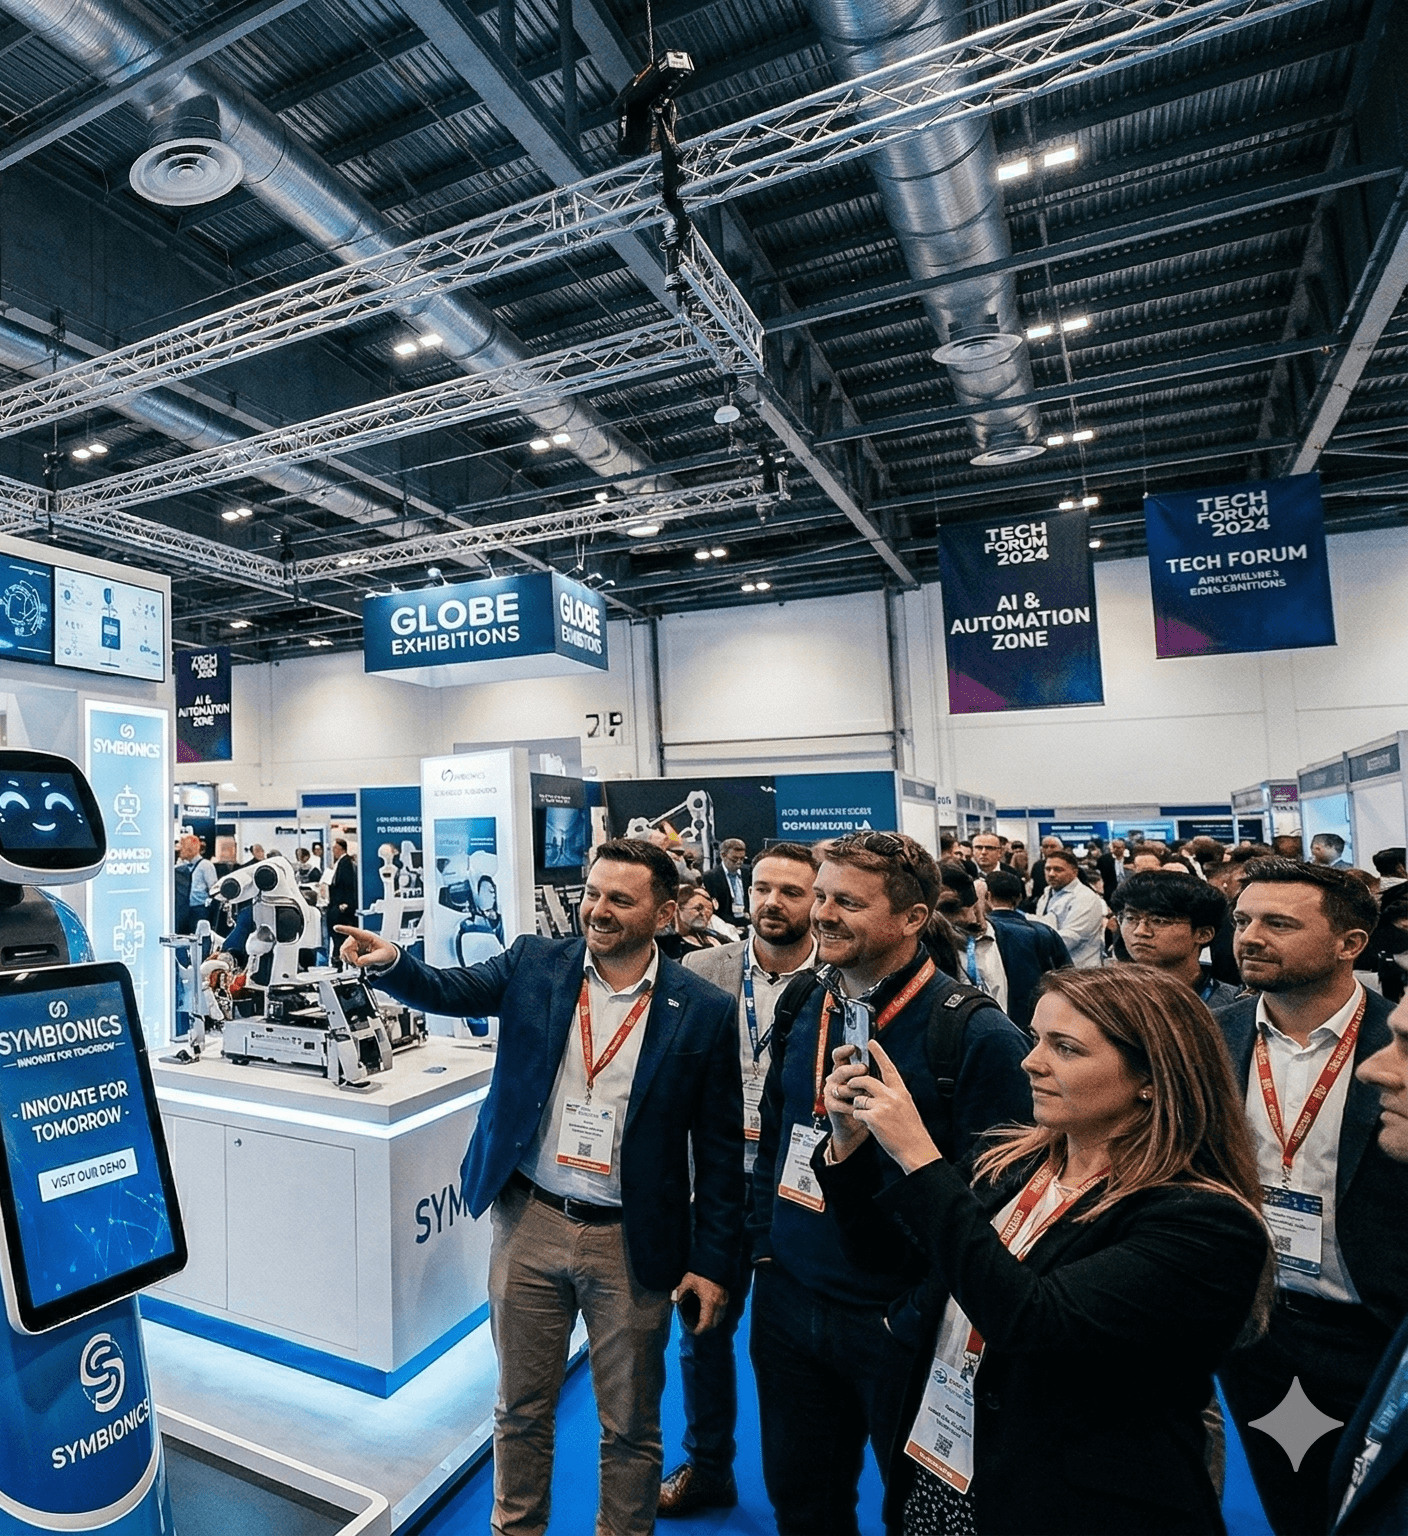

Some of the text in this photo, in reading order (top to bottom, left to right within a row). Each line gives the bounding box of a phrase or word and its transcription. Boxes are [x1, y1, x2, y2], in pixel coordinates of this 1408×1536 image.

[1196, 489, 1269, 512] TECH
[1196, 504, 1269, 525] FORUM
[1211, 517, 1271, 537] 2024
[985, 521, 1048, 541] TECH
[984, 535, 1048, 554] FORUM
[997, 547, 1050, 566] 2024
[1165, 544, 1308, 574] TECH FORUM
[390, 592, 520, 636] GLOBE
[996, 591, 1041, 612] AI &
[559, 592, 601, 637] GLOBE
[950, 606, 1091, 635] AUTOMATION
[391, 625, 520, 656] EXHIBITIONS
[991, 630, 1049, 651] ZONE
[20, 1080, 129, 1121] INNOVATE FOR
[31, 1105, 122, 1144] TOMORROW
[50, 1172, 76, 1190] VISIT
[77, 1165, 99, 1182] OUR
[51, 1396, 150, 1470] SYMBIONICS
